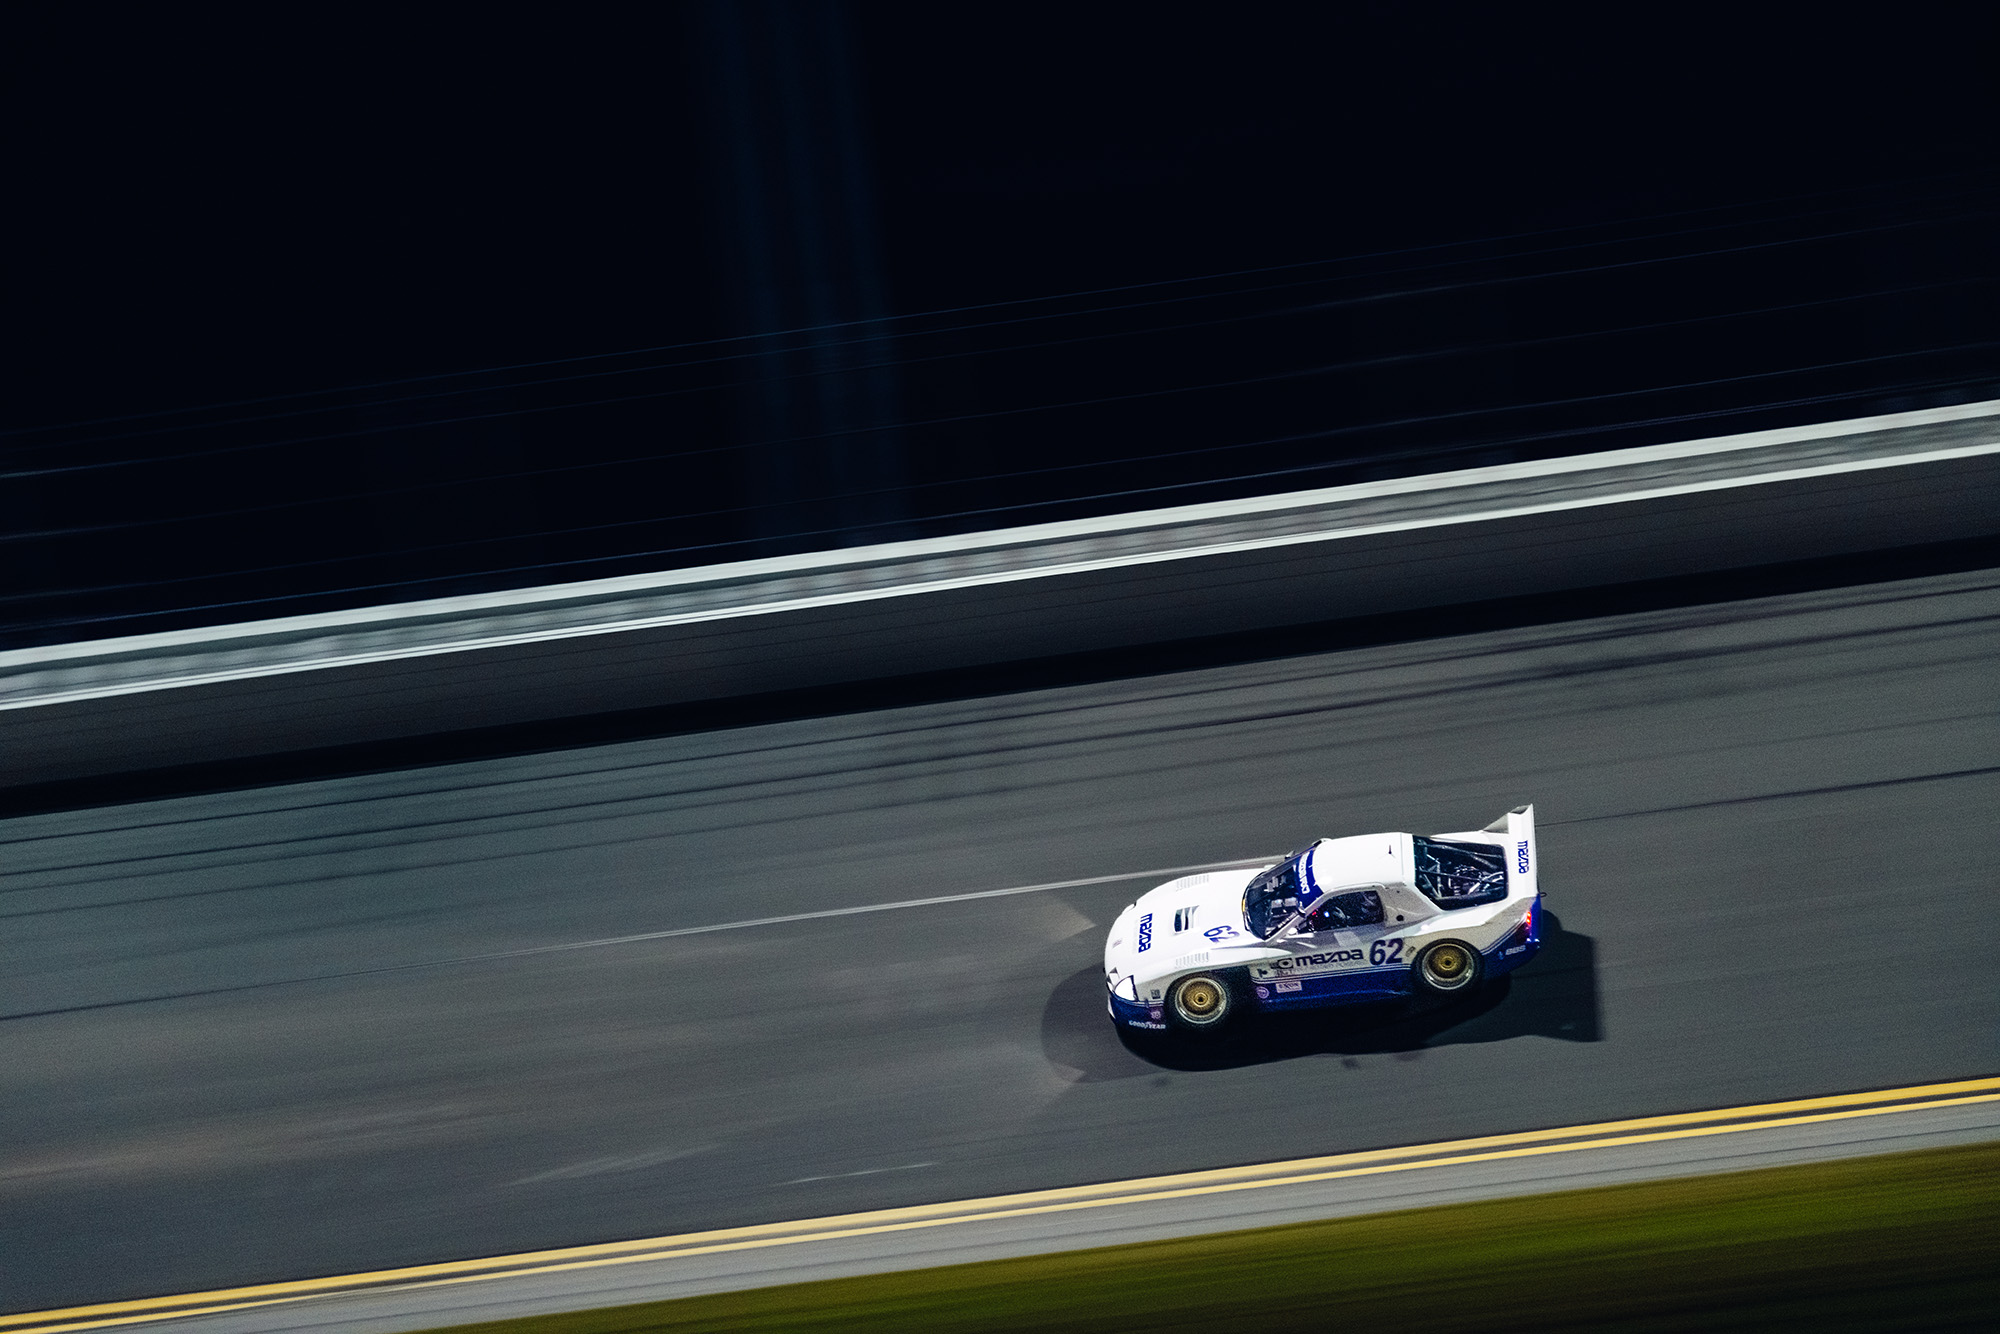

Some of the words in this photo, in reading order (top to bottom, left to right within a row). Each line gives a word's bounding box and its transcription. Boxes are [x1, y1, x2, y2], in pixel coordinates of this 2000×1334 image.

[1517, 840, 1529, 874] mazda
[1138, 913, 1153, 953] mazda
[1295, 949, 1364, 967] mazda
[1369, 937, 1403, 966] 62
